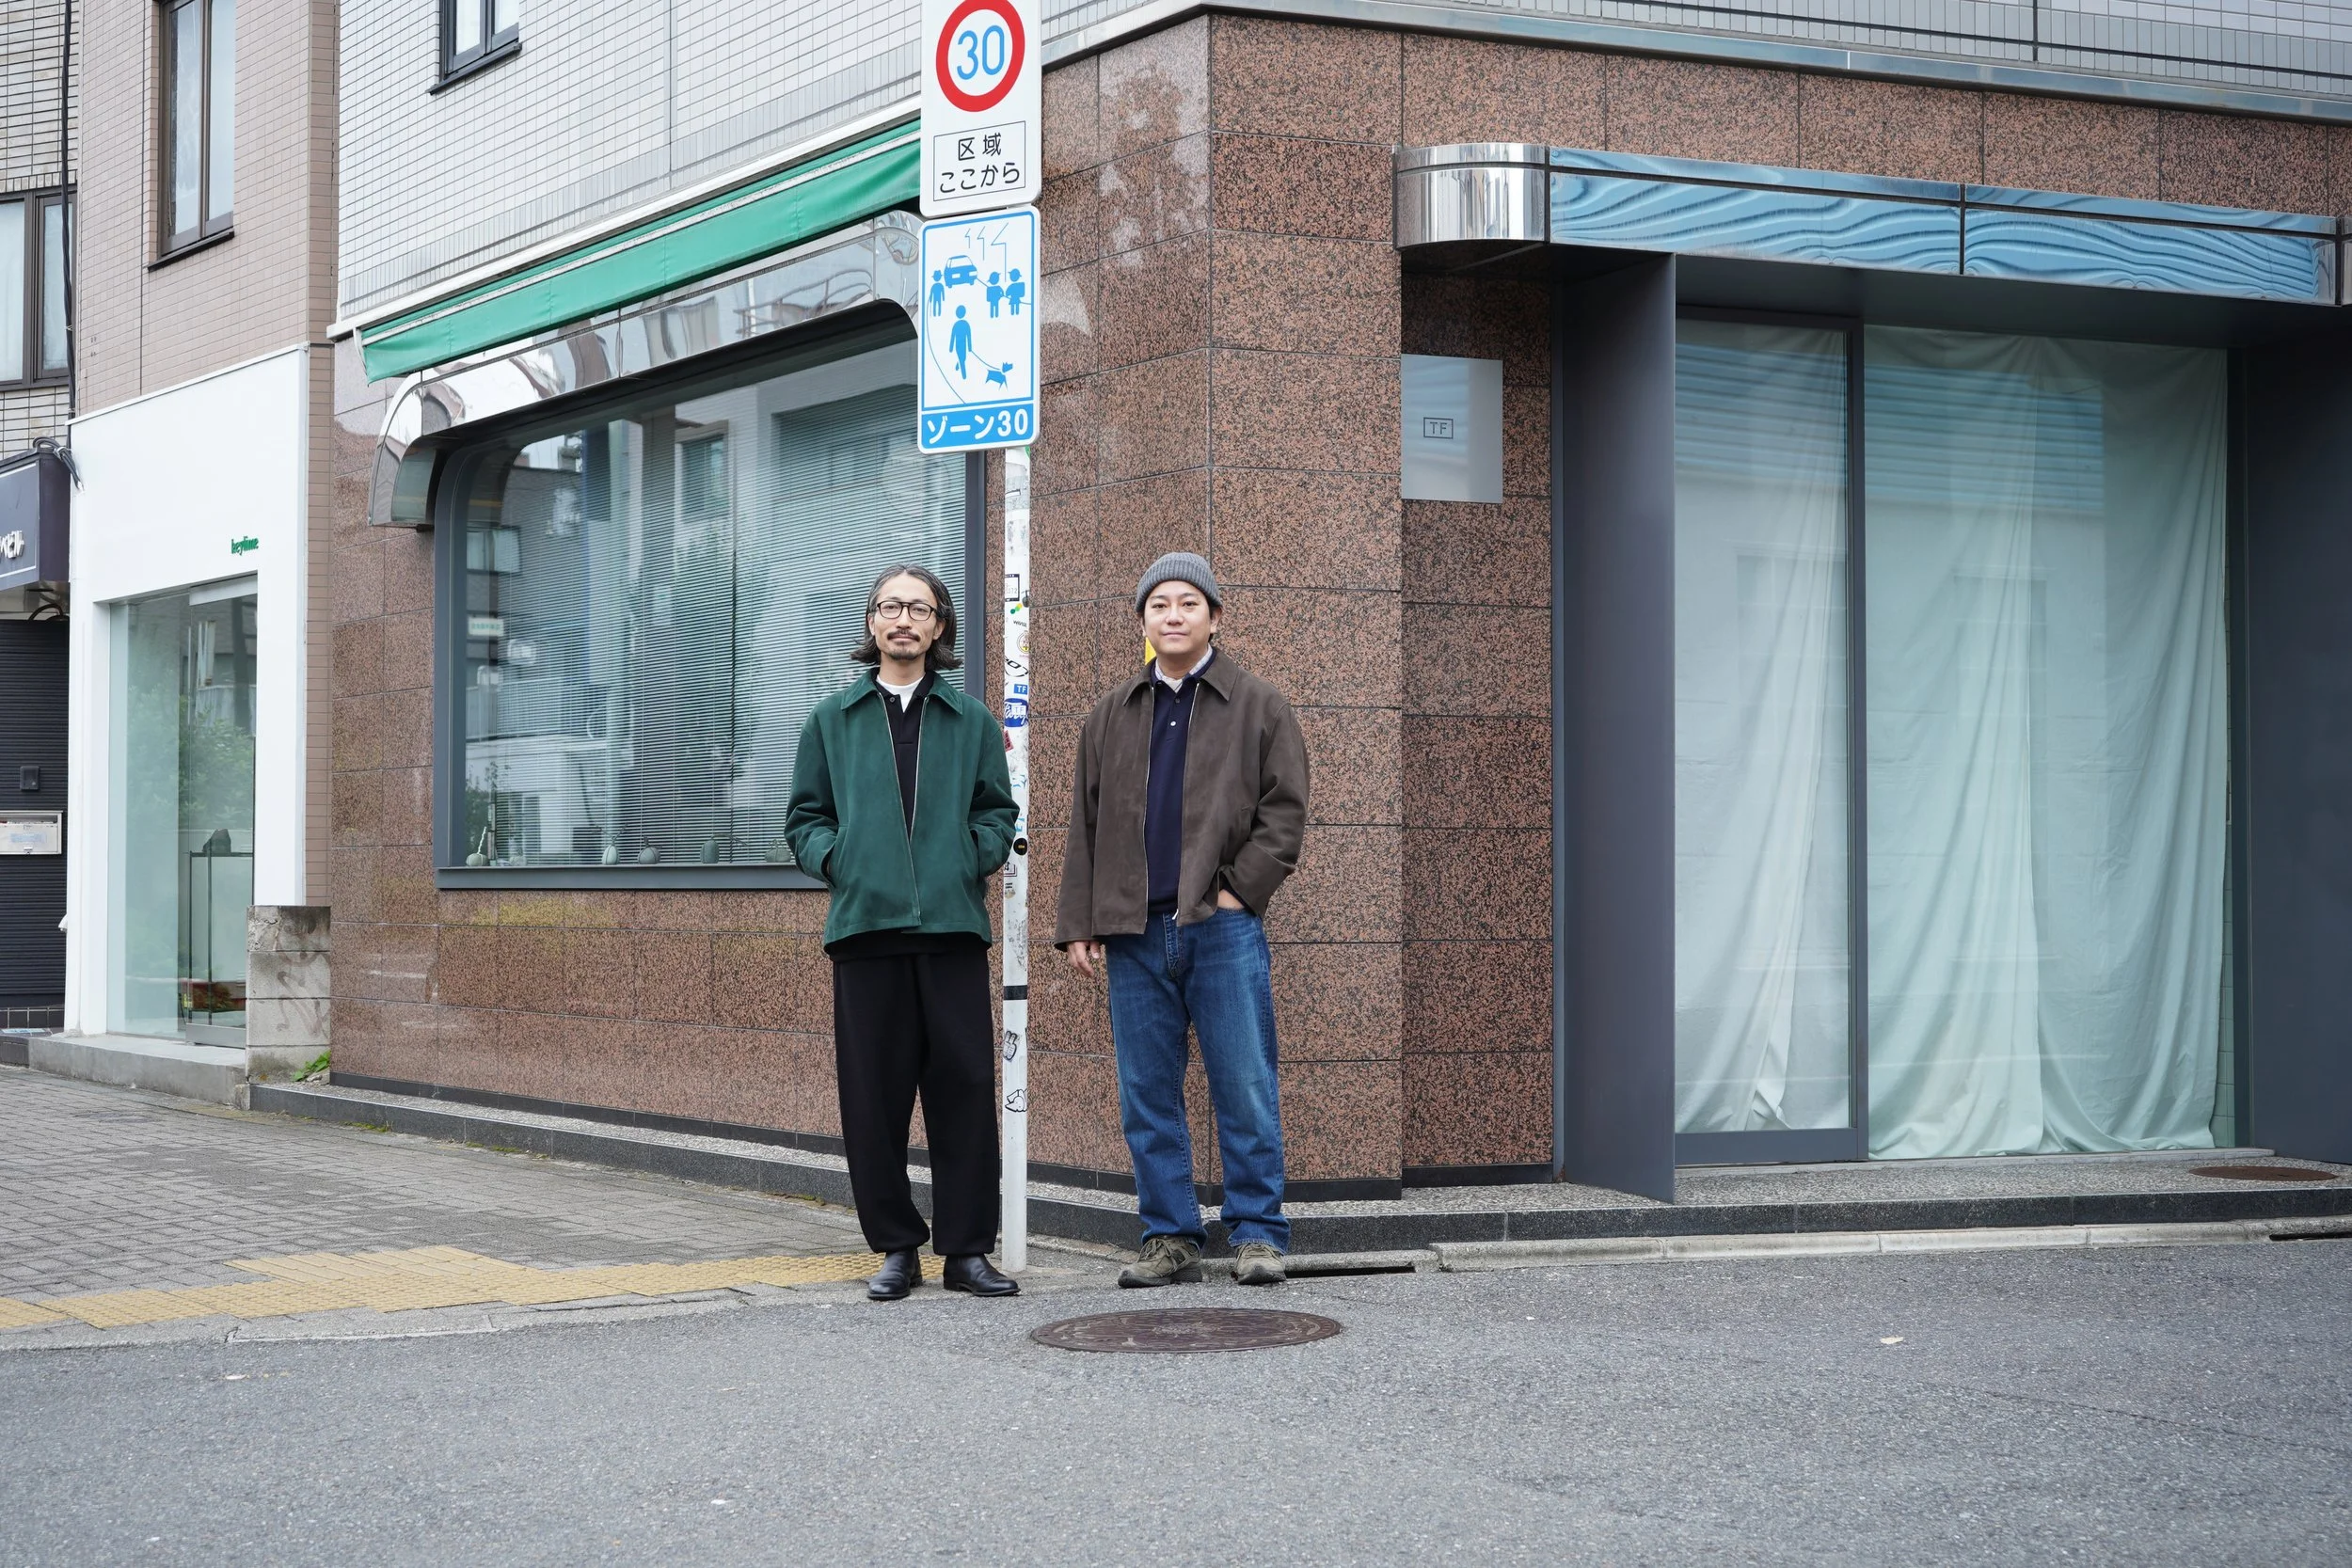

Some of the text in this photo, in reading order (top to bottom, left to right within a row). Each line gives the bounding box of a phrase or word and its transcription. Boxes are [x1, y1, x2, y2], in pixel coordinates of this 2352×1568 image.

[957, 24, 1005, 80] 30
[958, 132, 1002, 162] 区域
[939, 162, 1020, 194] ここから
[927, 408, 1028, 444] ゾーン30
[1429, 421, 1448, 435] TF
[1016, 685, 1027, 693] TF
